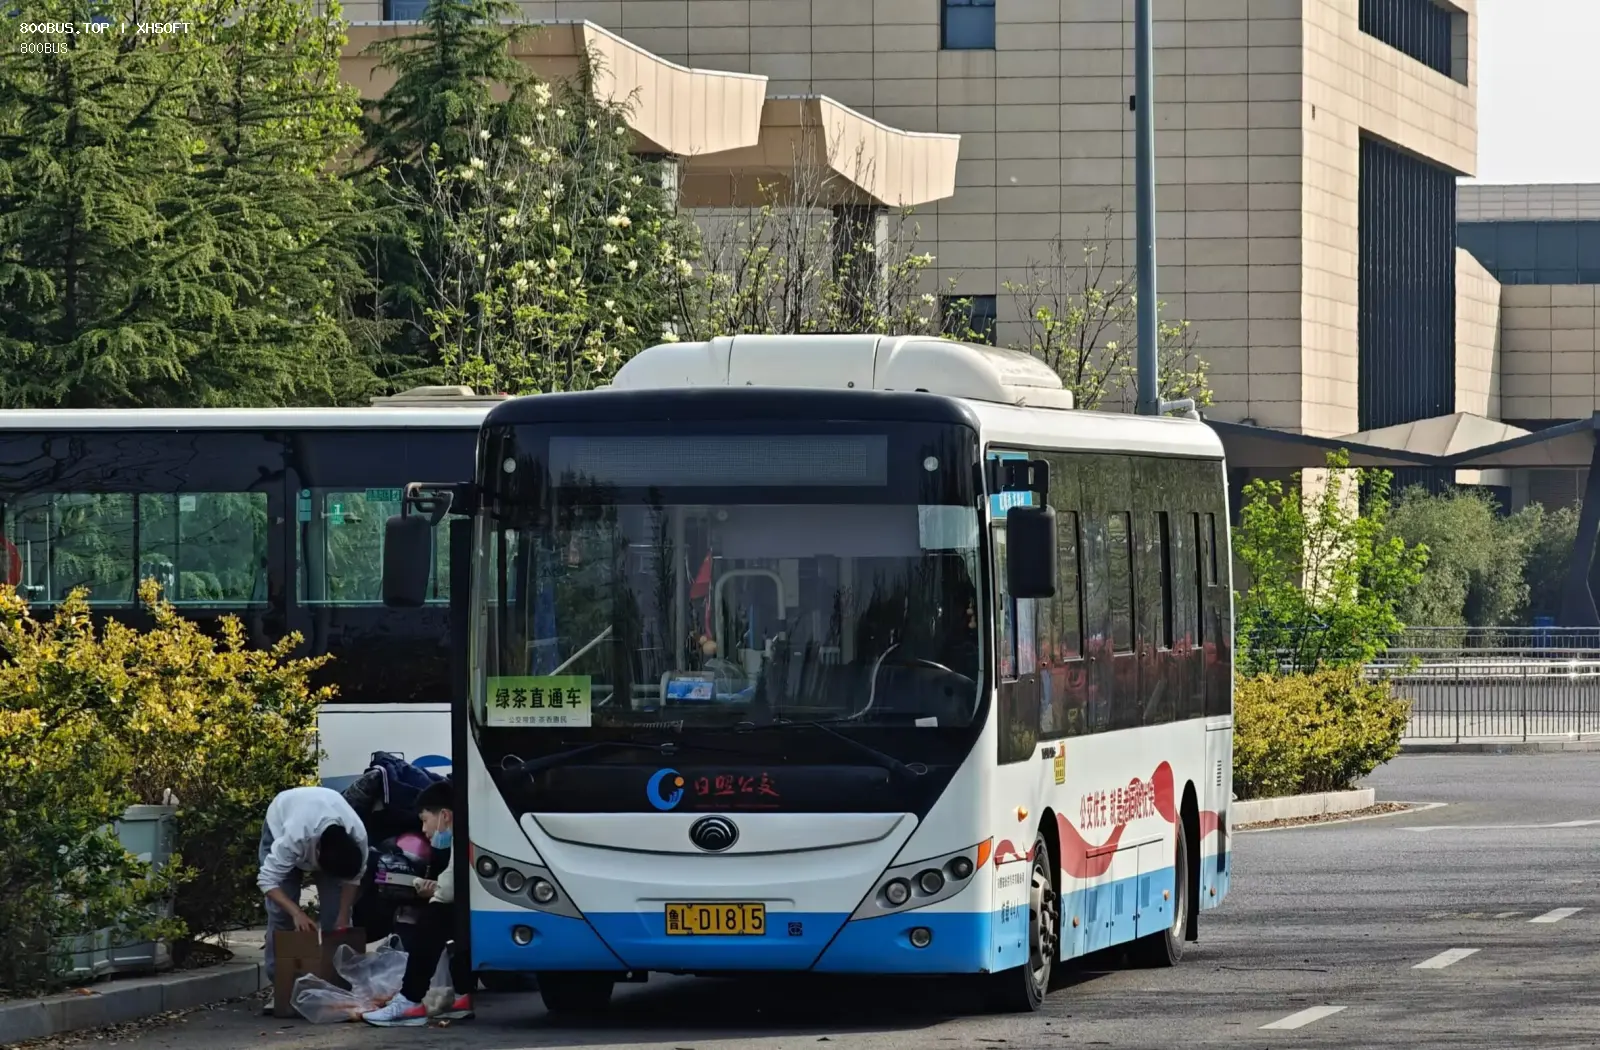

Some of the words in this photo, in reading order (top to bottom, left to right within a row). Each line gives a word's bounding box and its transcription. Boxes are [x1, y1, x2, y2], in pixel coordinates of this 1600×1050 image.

[495, 687, 582, 709] 绿茶直通车
[694, 772, 780, 797] 日照公交
[1080, 789, 1107, 830] 公交优先
